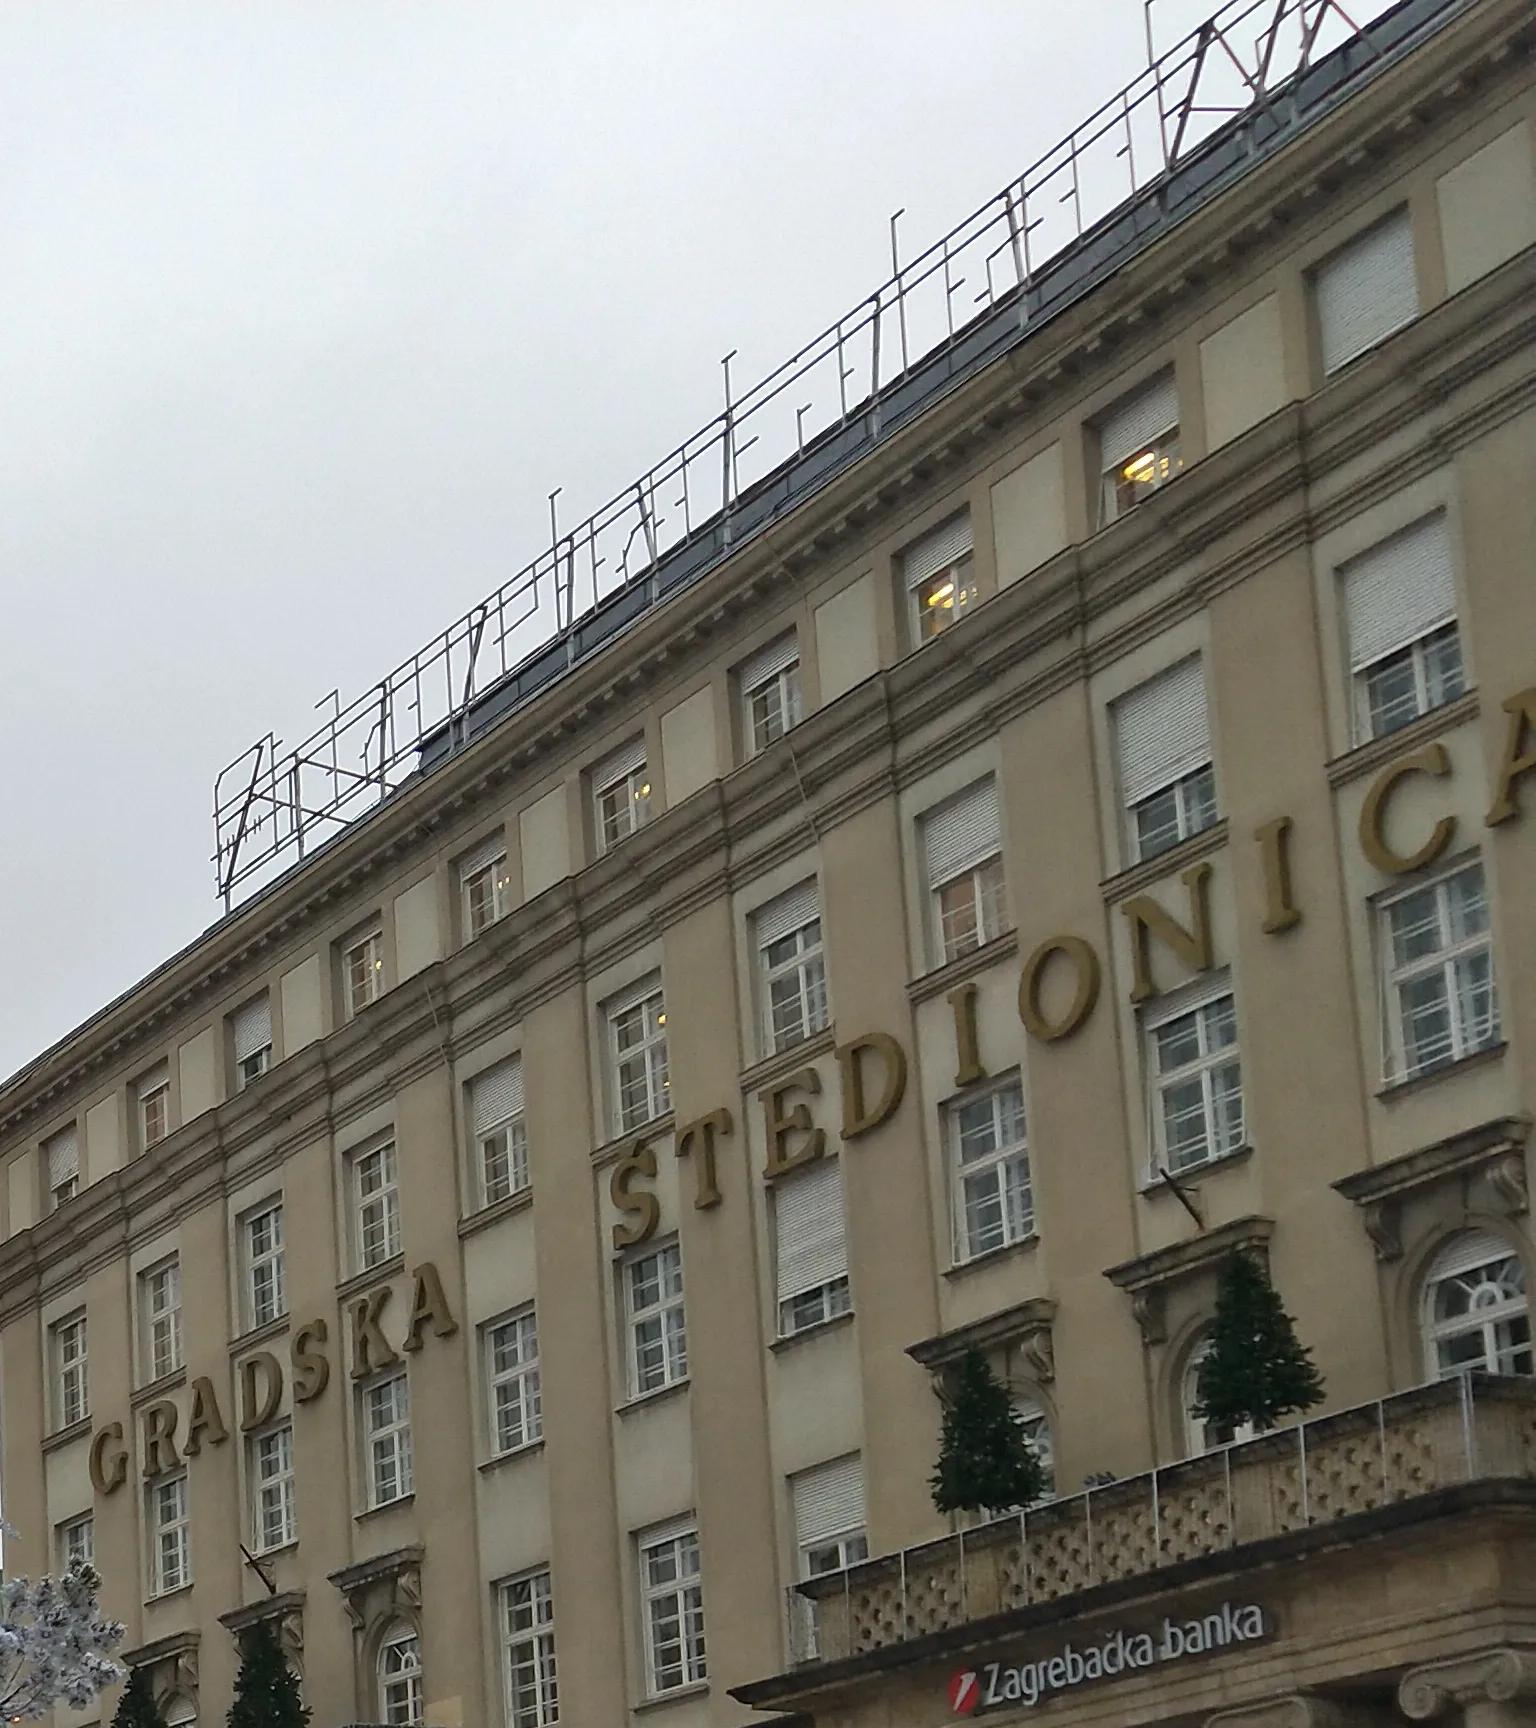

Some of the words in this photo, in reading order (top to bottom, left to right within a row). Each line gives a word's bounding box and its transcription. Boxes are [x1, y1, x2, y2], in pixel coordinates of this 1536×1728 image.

[89, 1261, 459, 1496] GRADSKA
[981, 1630, 1154, 1706] Zagrebačka
[1163, 1601, 1264, 1660] banka
